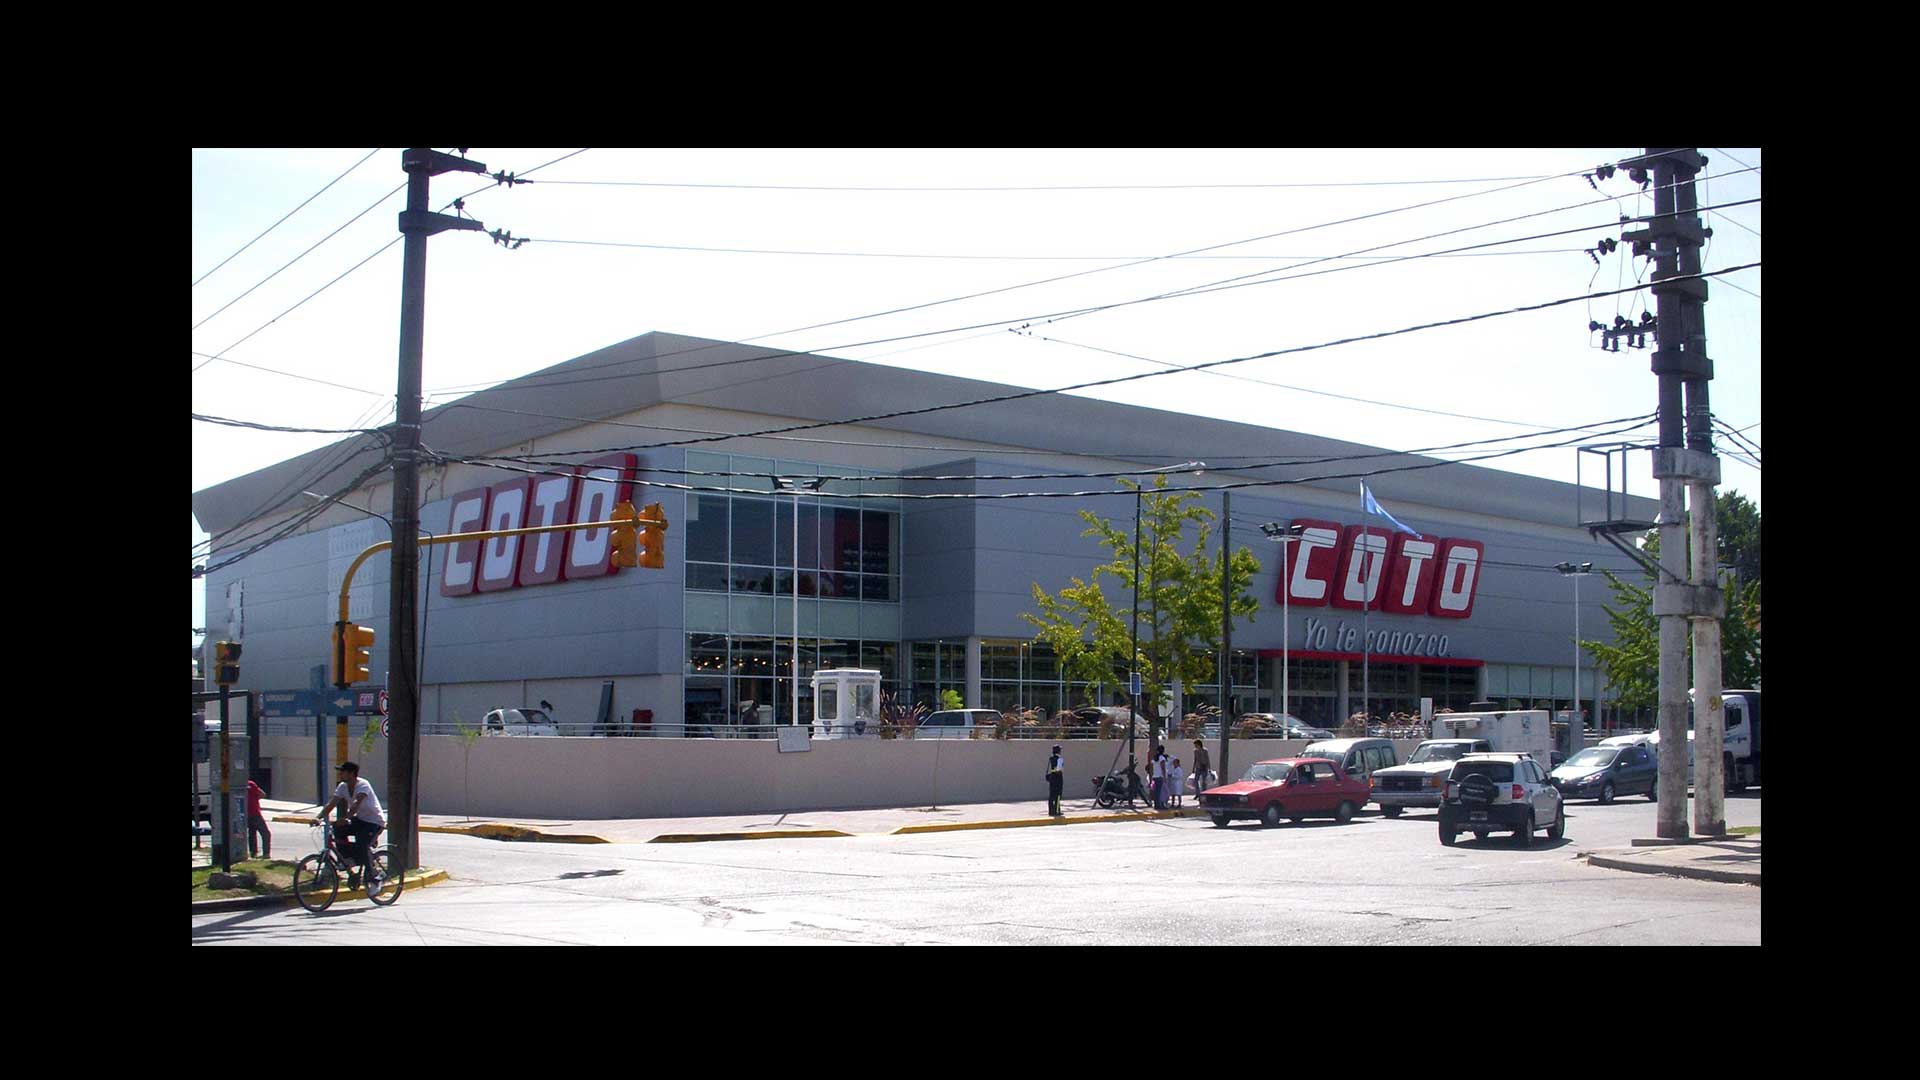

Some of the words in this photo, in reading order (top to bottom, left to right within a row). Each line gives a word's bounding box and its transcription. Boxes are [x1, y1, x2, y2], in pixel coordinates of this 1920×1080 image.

[445, 468, 618, 587] COTO
[1290, 527, 1478, 611] COTO
[1305, 617, 1328, 651] Yo
[1336, 621, 1357, 652] te
